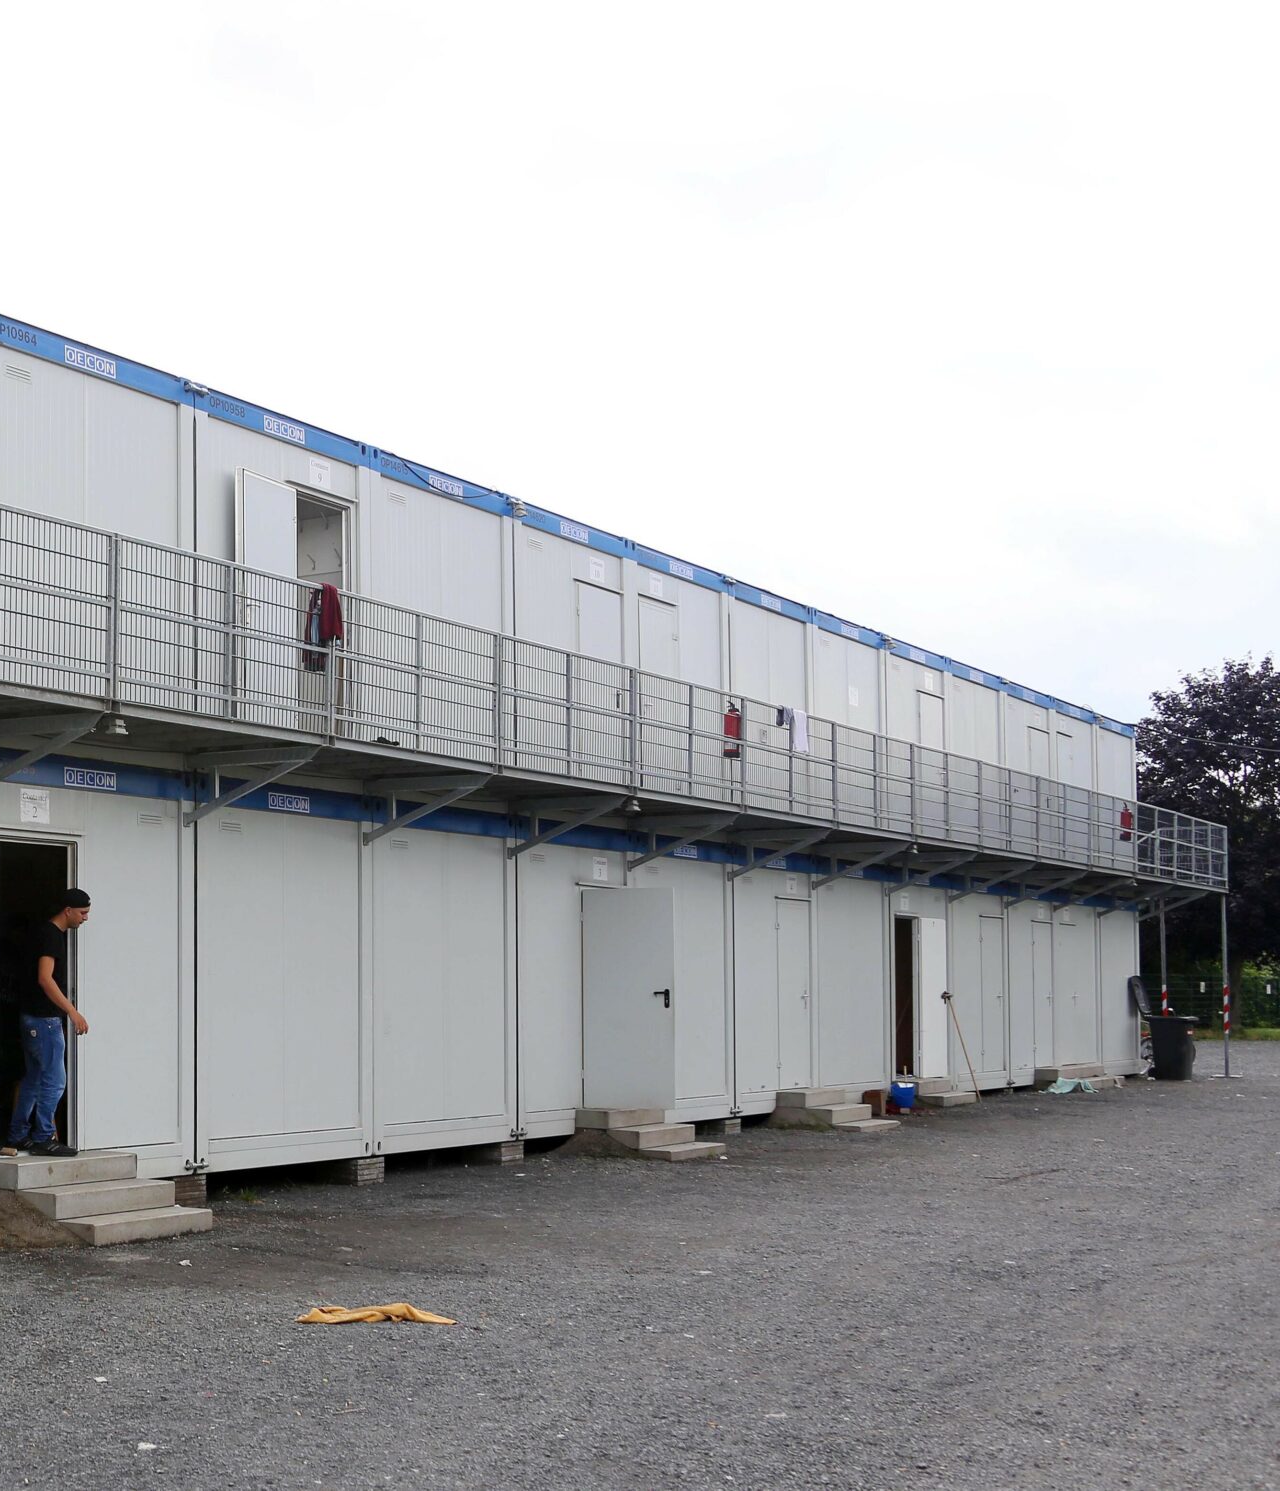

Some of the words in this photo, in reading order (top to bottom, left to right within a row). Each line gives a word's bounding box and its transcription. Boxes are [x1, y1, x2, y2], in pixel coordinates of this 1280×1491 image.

[66, 348, 115, 376] OECON
[209, 396, 245, 418] OP10958
[265, 416, 304, 442] OECON
[317, 473, 323, 482] 9
[430, 476, 462, 497] OECON
[66, 771, 115, 788] OECON
[32, 806, 38, 818] 2
[269, 794, 309, 811] OECON
